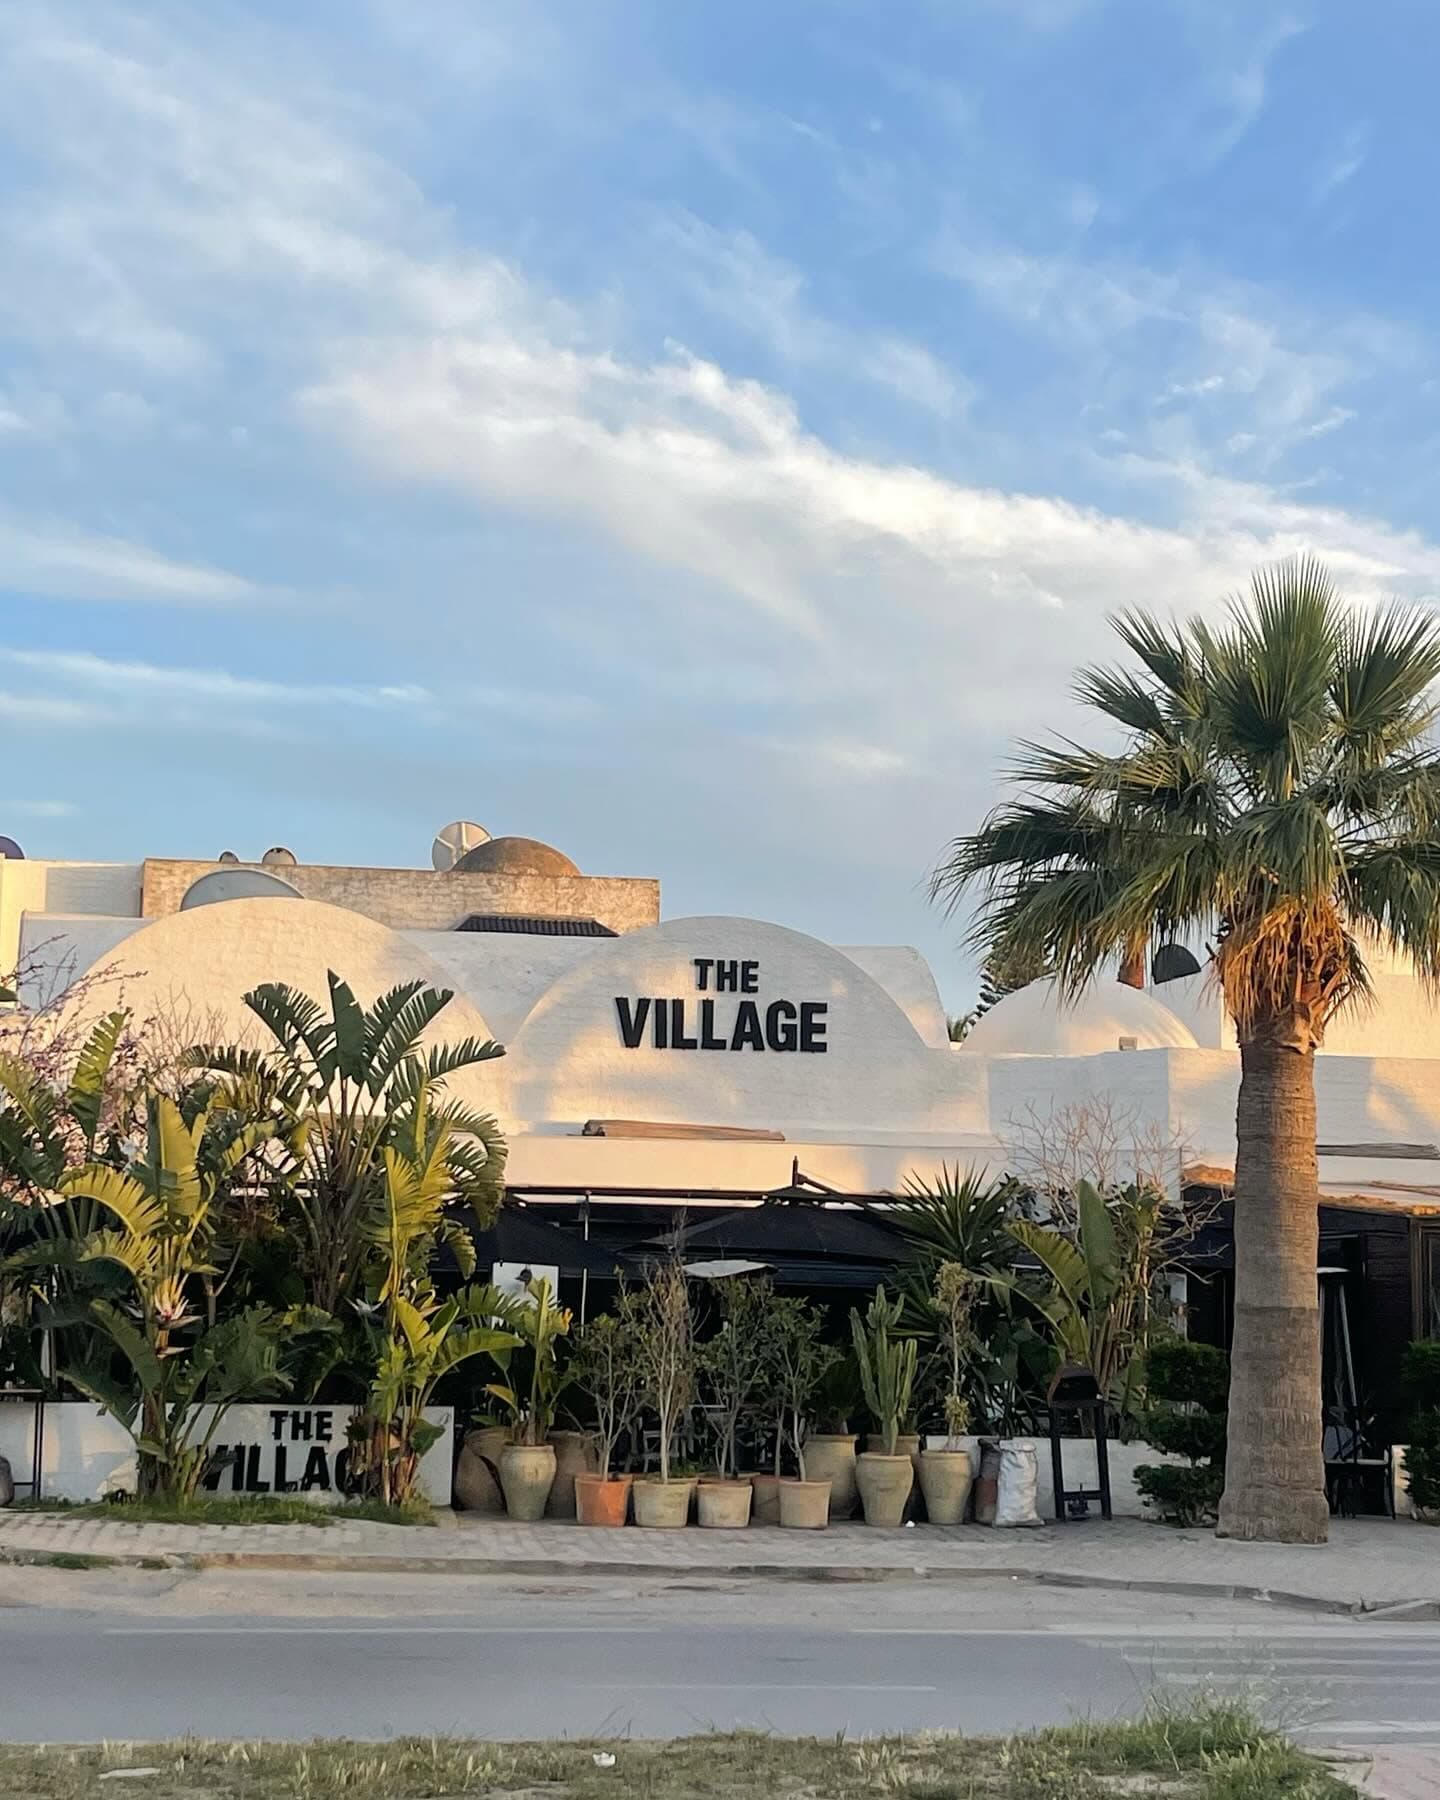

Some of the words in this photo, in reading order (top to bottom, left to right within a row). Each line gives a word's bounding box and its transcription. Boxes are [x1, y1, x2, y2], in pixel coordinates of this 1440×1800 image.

[694, 958, 760, 993] THE
[615, 997, 828, 1053] VILLAGE
[270, 1410, 333, 1441] THE
